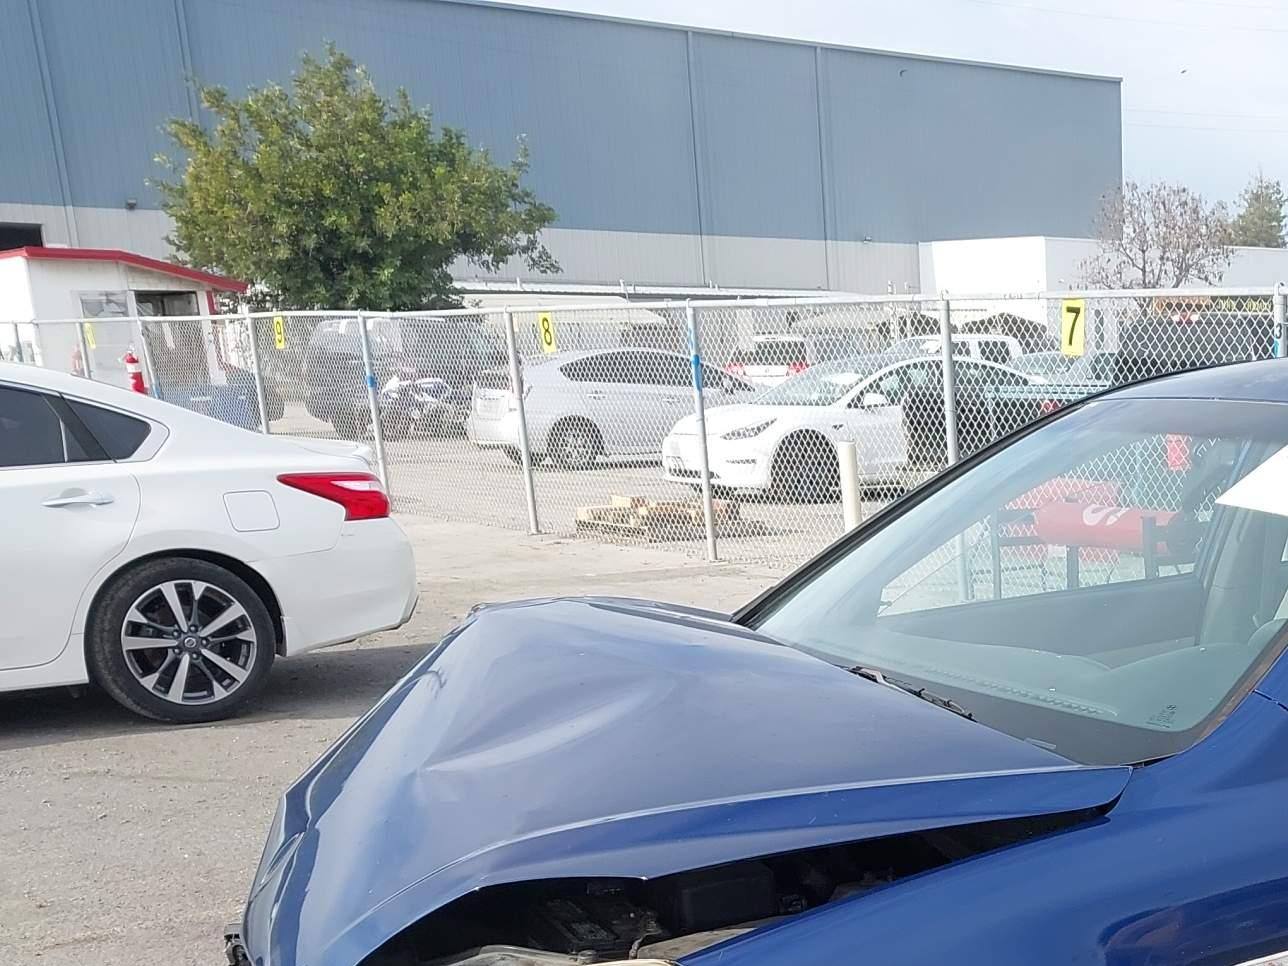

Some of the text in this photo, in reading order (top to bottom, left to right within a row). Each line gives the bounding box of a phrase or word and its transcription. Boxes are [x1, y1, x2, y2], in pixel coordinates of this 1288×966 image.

[275, 320, 283, 344] 9
[541, 316, 553, 347] 8
[1065, 306, 1081, 347] 7
